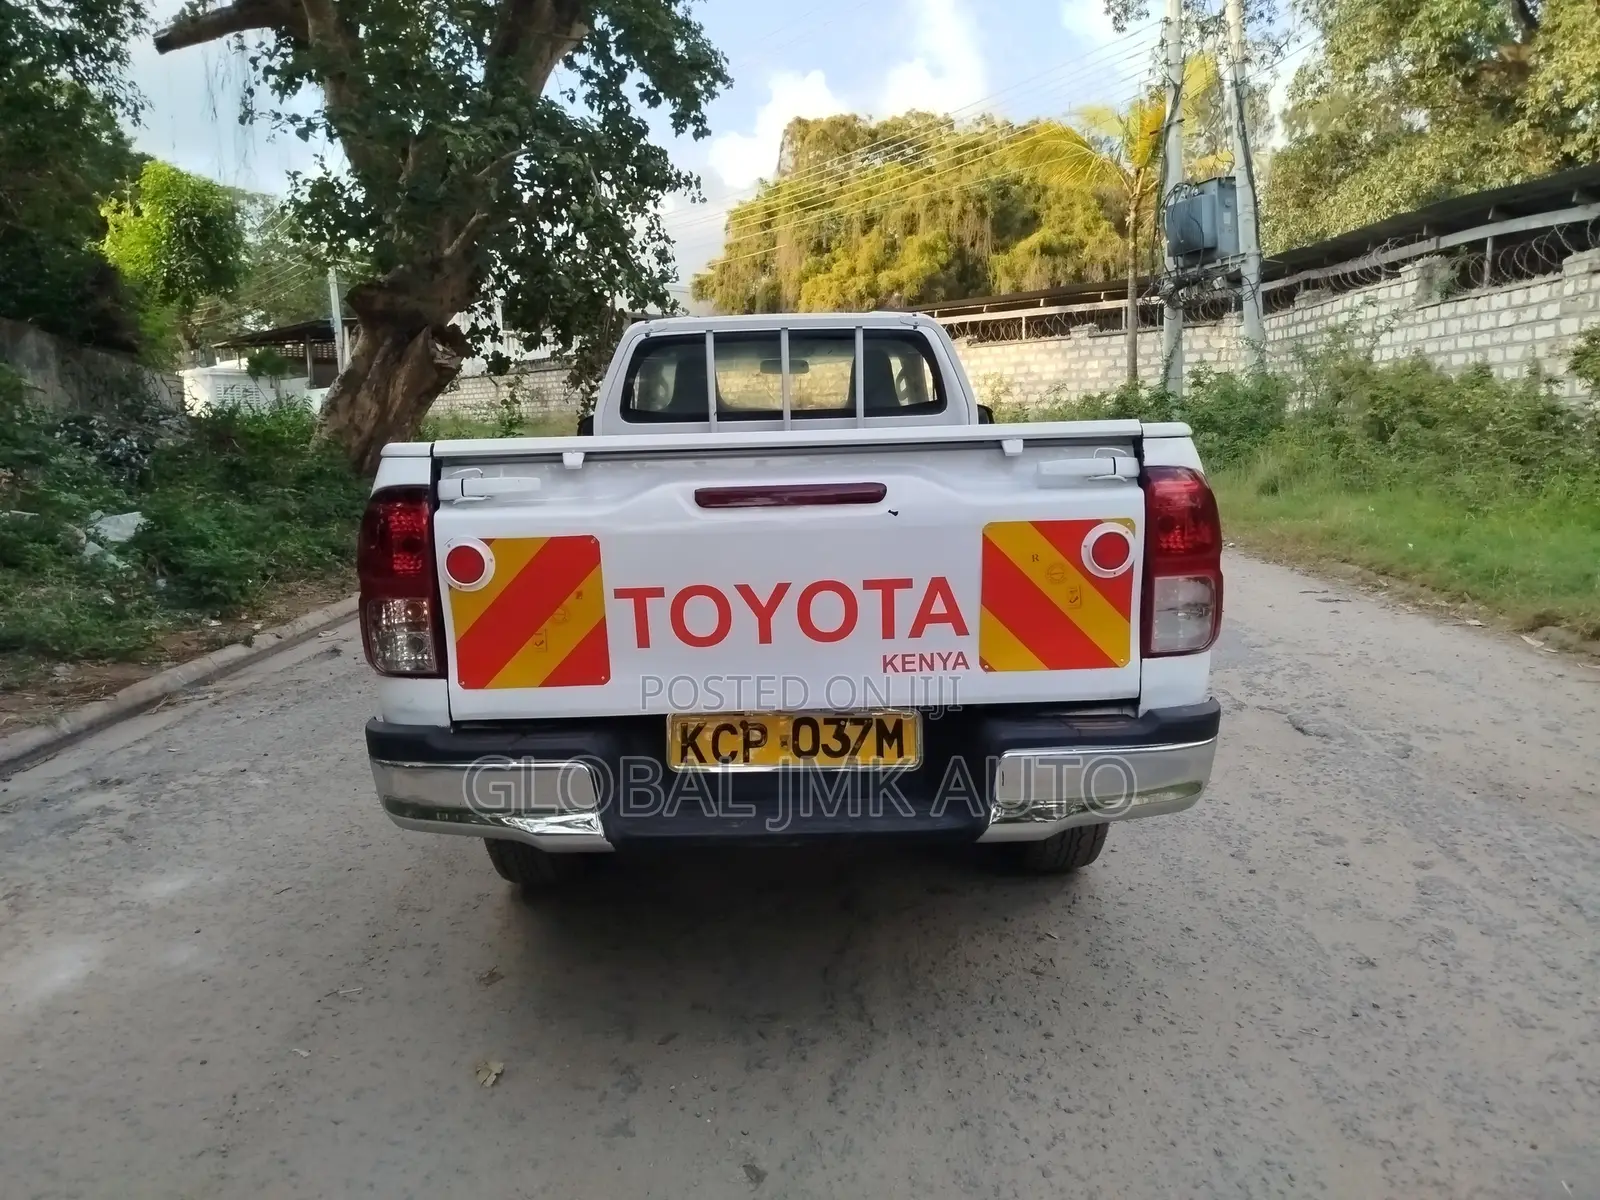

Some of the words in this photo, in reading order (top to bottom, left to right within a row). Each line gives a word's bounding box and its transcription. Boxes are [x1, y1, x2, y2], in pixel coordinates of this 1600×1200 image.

[613, 576, 970, 649] TOYOTA
[882, 651, 970, 674] KENYA
[679, 719, 769, 764] KCP
[791, 716, 904, 760] 037M
